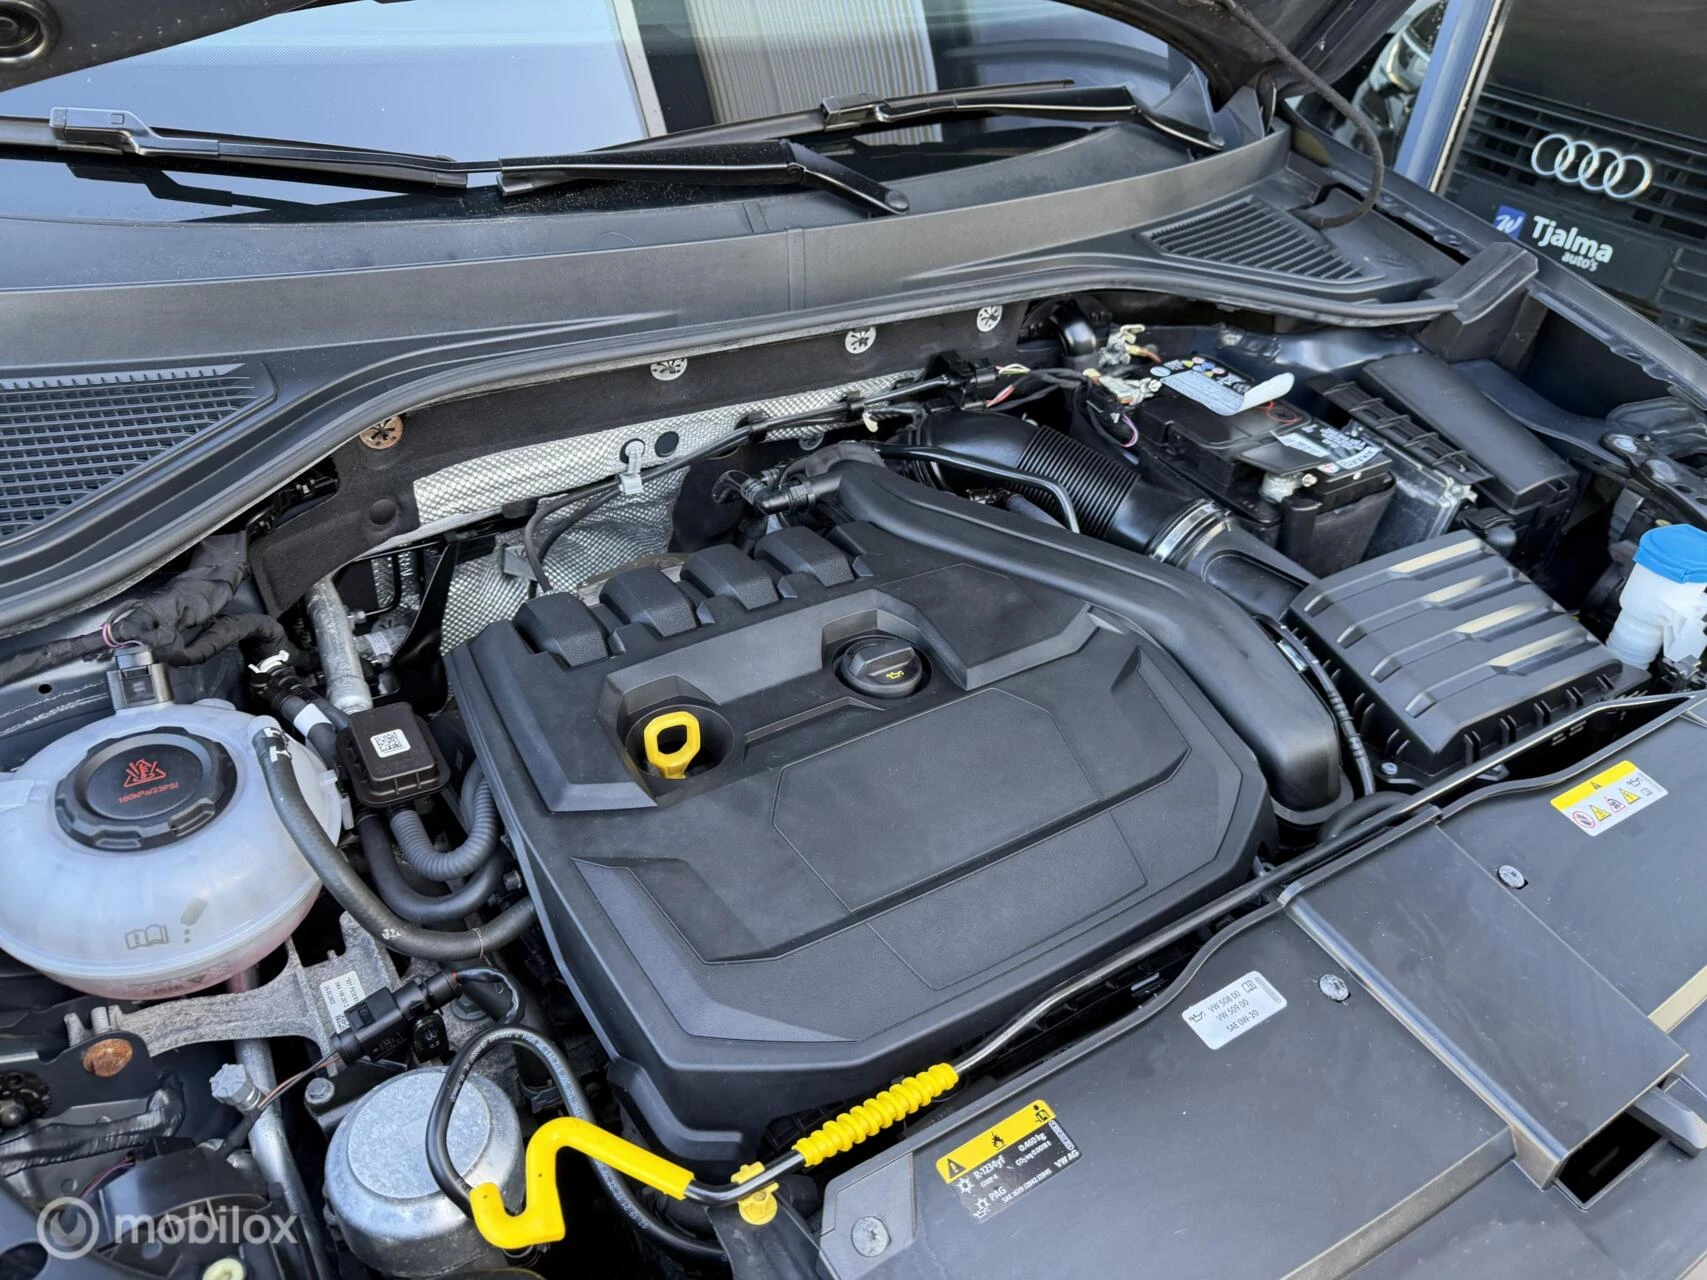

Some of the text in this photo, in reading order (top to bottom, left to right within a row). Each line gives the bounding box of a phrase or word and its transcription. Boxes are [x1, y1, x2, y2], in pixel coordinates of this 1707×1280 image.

[1532, 215, 1613, 263] Tjalma
[1561, 251, 1598, 272] auto's
[1207, 990, 1241, 1013] VW 508 00
[1215, 998, 1249, 1022] VW 509 00
[1225, 1009, 1260, 1033] SAE 0W-20
[988, 1149, 1080, 1201] PAG VW AG
